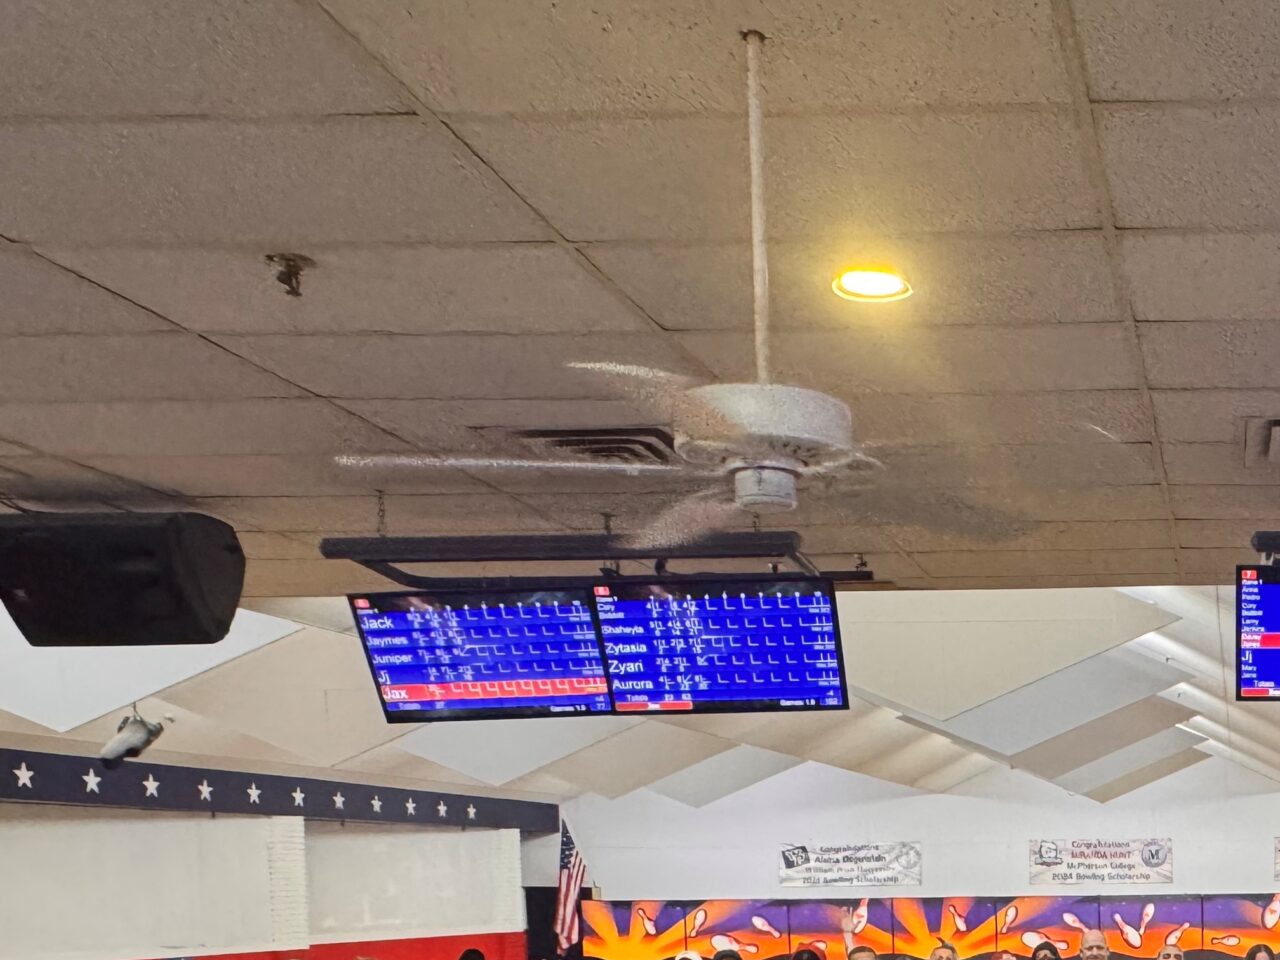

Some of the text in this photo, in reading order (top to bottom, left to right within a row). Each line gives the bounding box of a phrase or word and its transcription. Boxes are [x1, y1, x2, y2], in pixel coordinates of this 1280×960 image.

[361, 616, 394, 629] Jack
[373, 653, 412, 665] Juniper
[383, 687, 408, 699] Jax
[1076, 873, 1105, 881] Bowling
[1107, 873, 1150, 881] Scholarship
